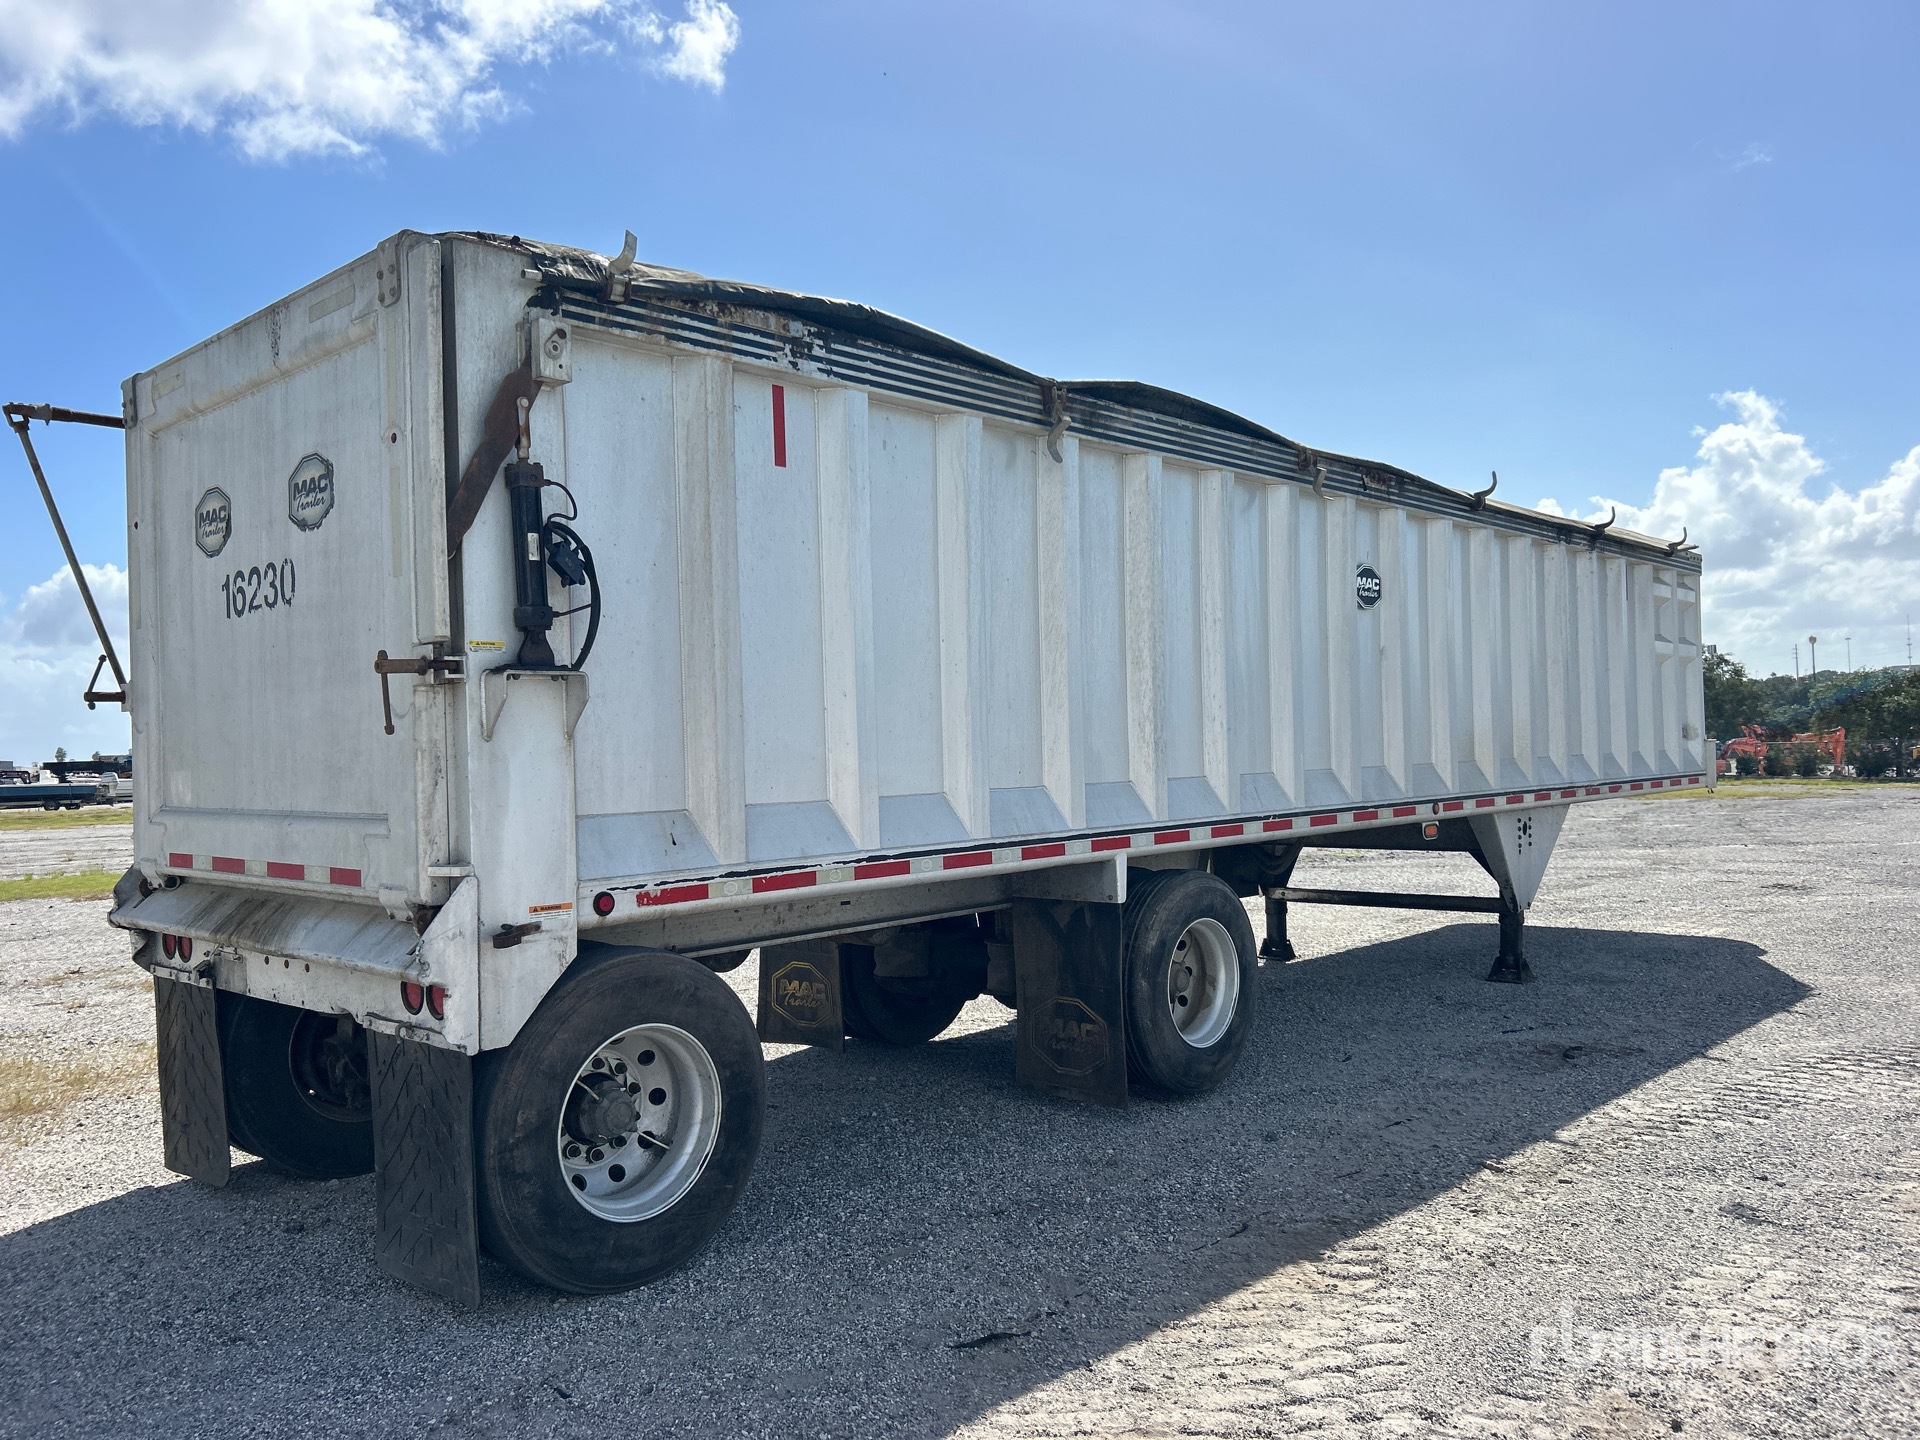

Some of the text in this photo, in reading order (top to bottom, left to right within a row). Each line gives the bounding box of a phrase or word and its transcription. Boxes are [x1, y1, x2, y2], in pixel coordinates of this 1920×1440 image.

[293, 473, 330, 501] MAC
[295, 491, 327, 512] Trailer
[199, 505, 227, 528] MAC
[201, 521, 226, 538] Trailer
[221, 558, 296, 619] 16230
[1356, 576, 1380, 590] MAC
[779, 979, 827, 1000] MAC
